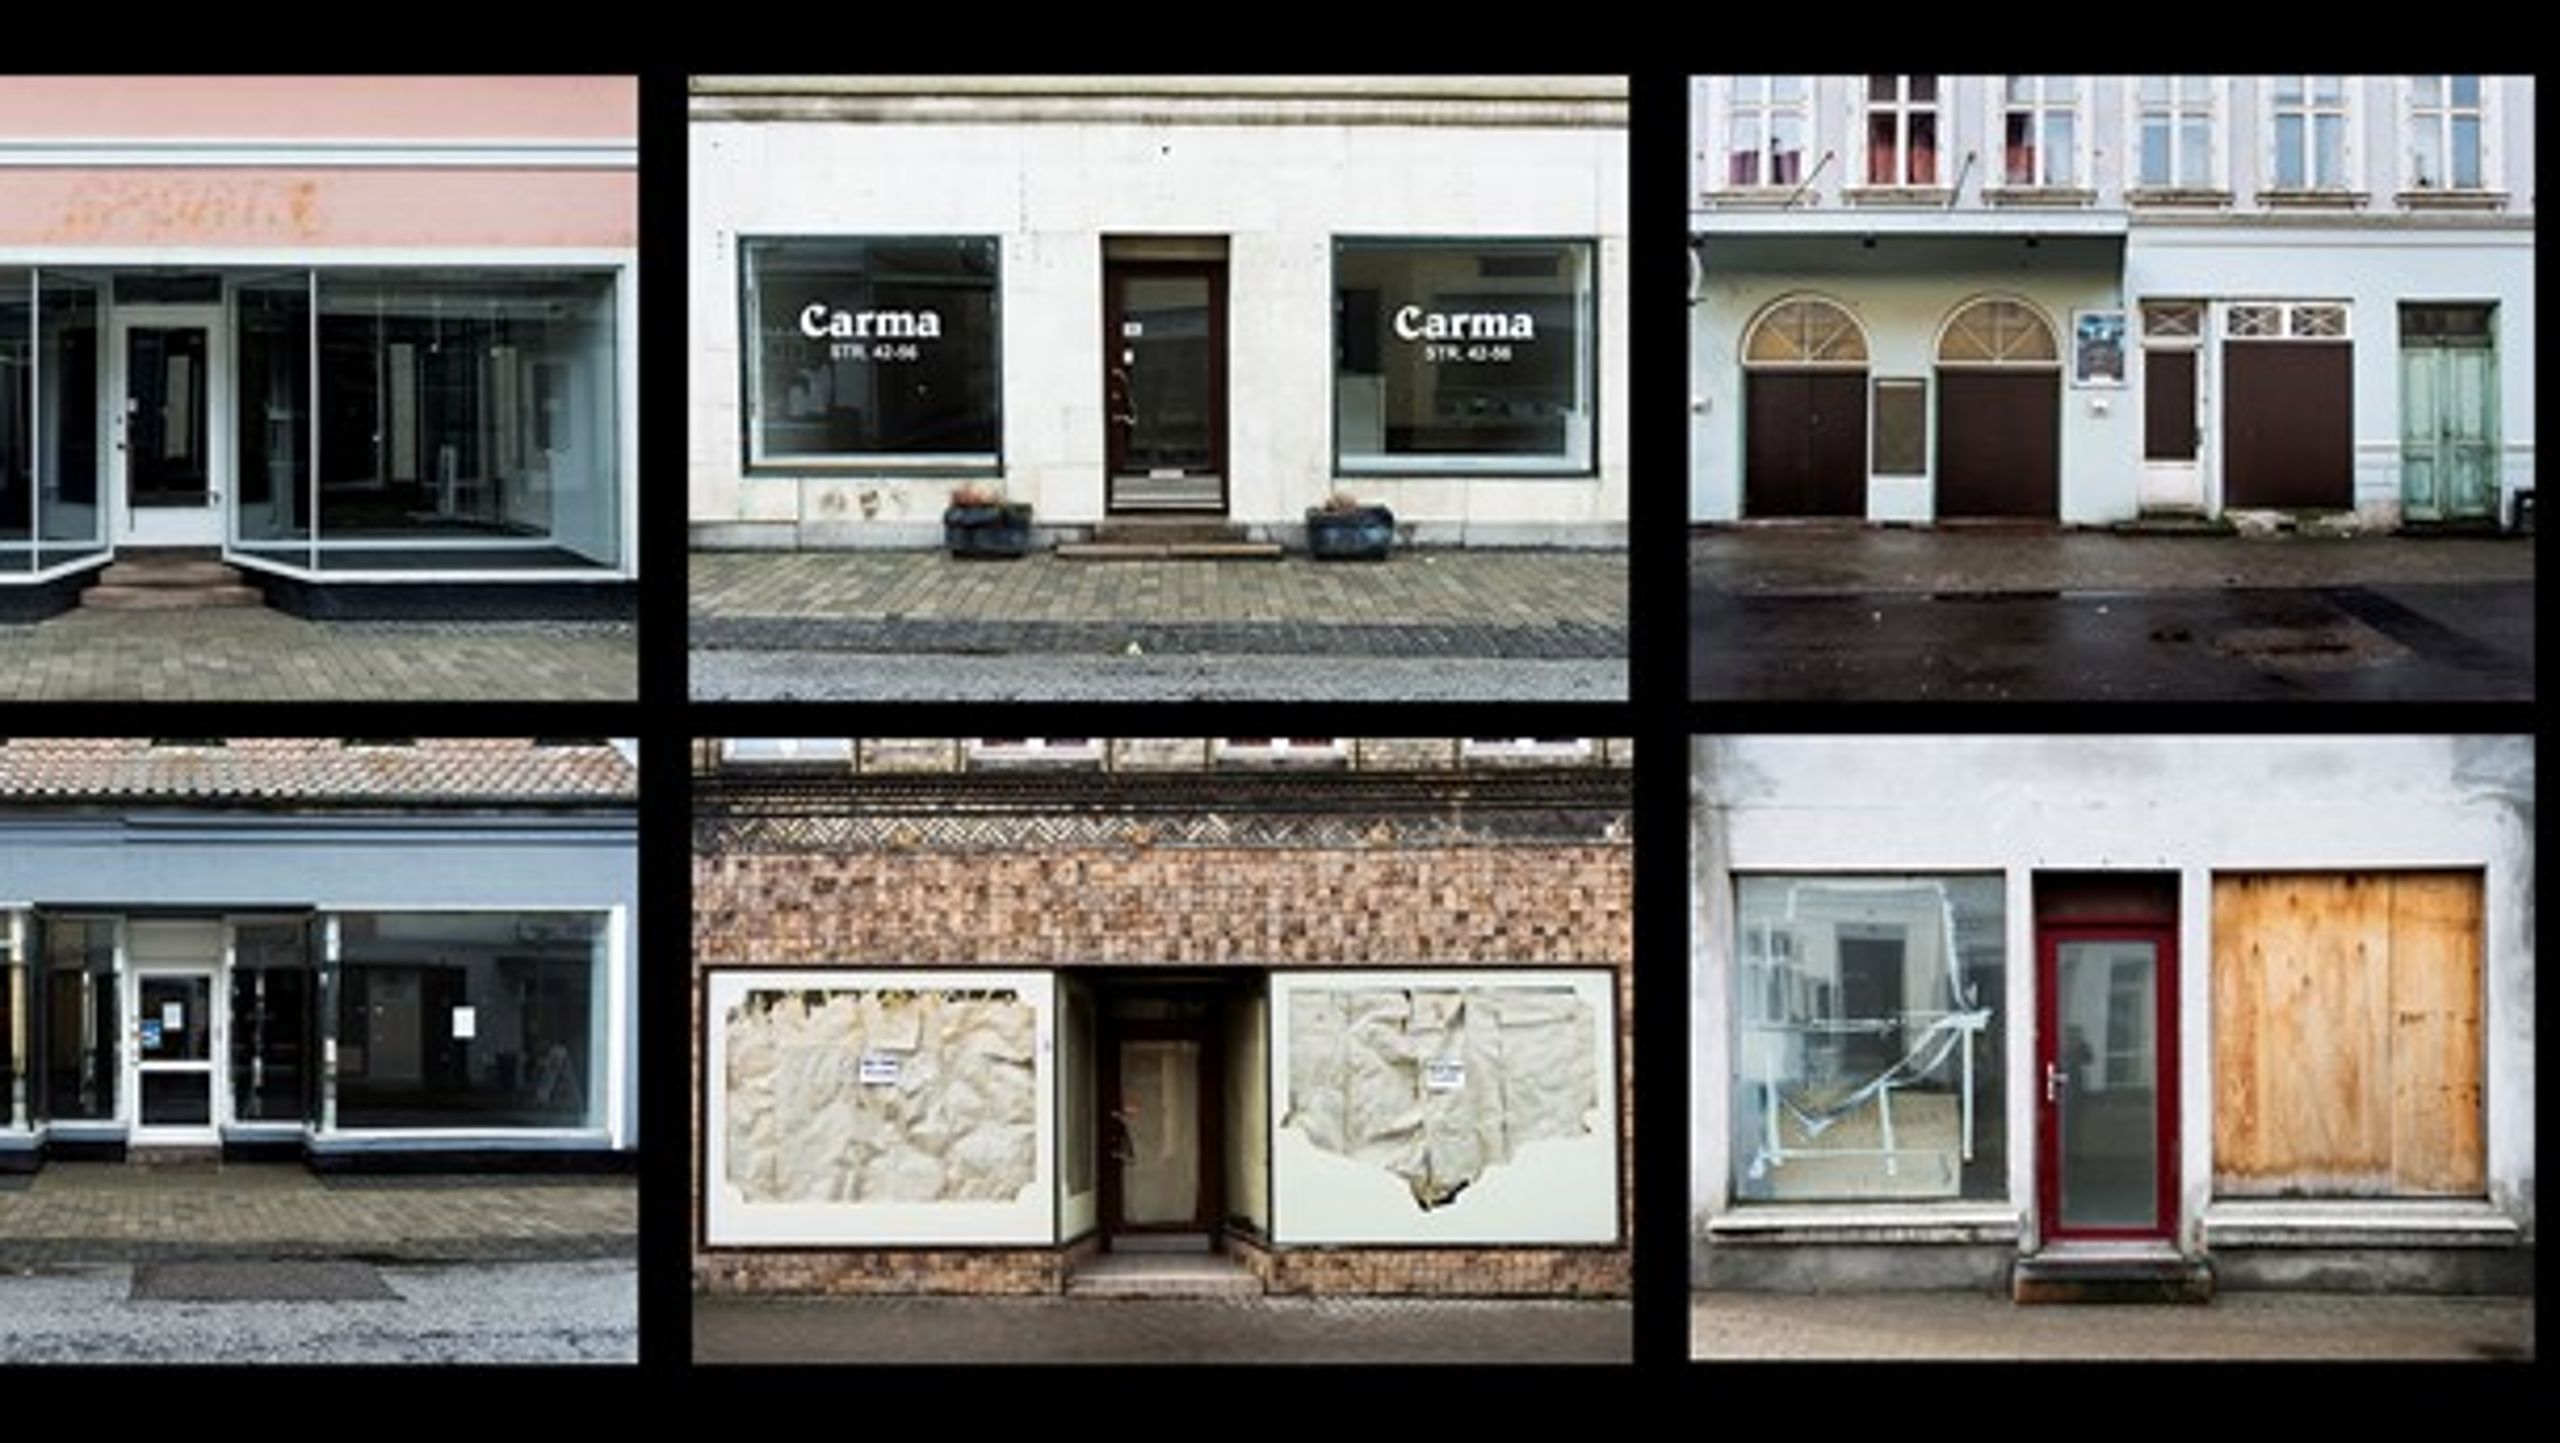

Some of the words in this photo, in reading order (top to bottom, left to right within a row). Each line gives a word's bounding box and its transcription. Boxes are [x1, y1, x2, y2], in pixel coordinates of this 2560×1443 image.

[801, 303, 942, 338] Carma
[1395, 304, 1534, 340] Carma
[1426, 344, 1463, 362] STR.
